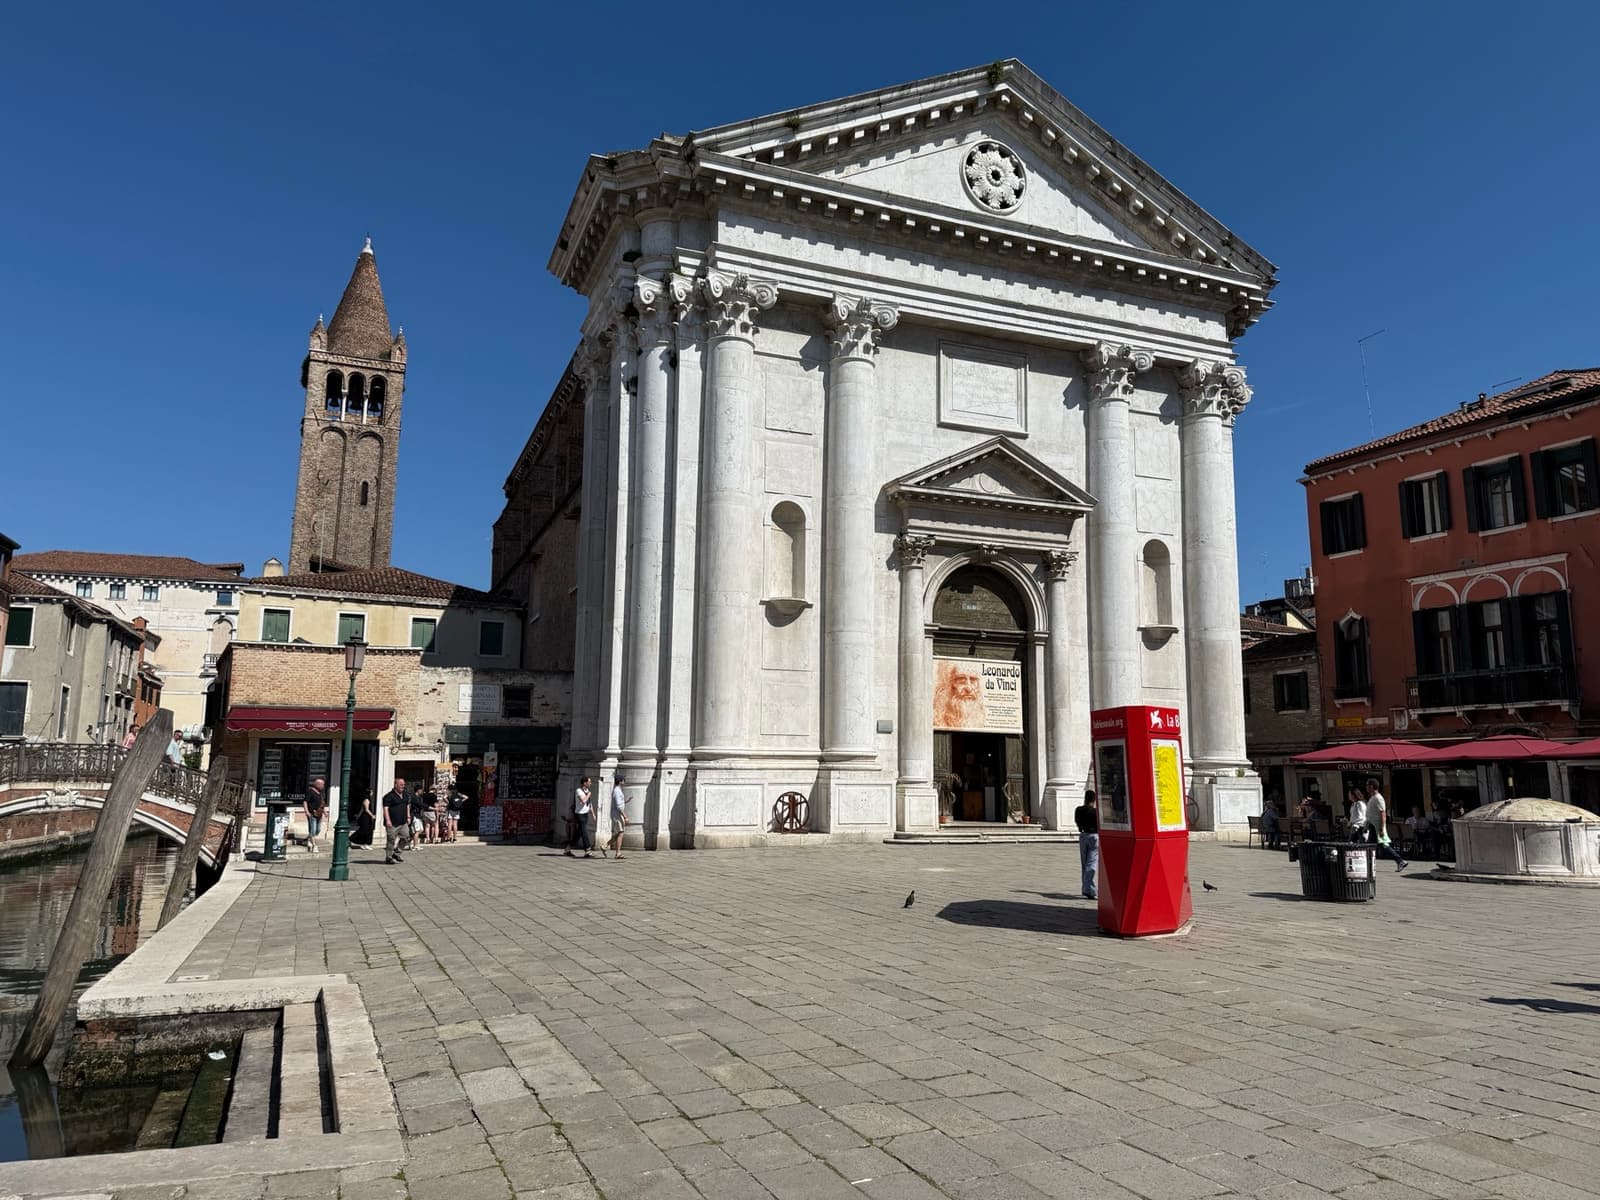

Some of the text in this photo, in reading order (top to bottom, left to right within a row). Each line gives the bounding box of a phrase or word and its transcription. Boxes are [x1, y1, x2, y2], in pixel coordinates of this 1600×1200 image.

[981, 663, 1020, 678] Leonardo
[985, 678, 1017, 691] da Vinci
[1166, 713, 1174, 728] La
